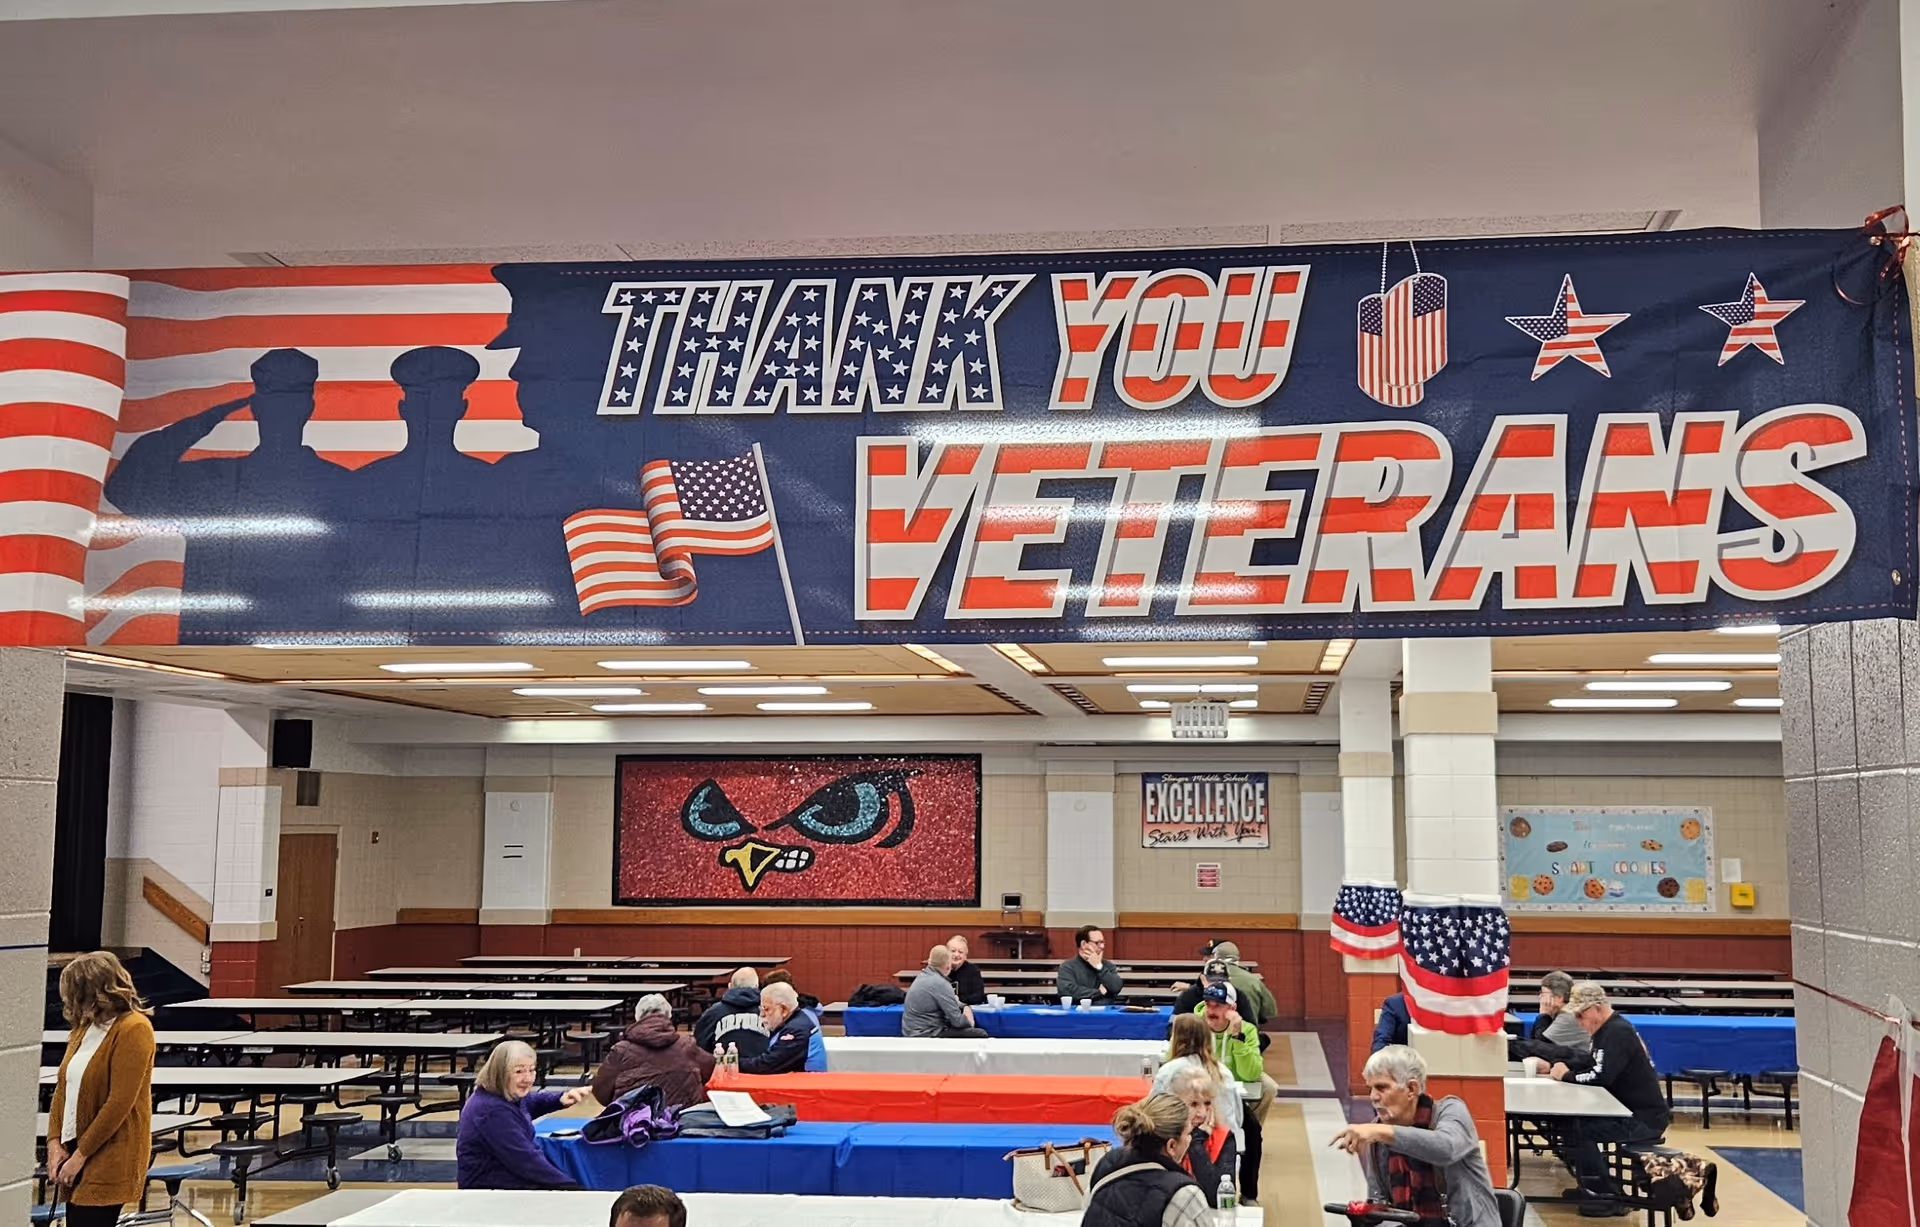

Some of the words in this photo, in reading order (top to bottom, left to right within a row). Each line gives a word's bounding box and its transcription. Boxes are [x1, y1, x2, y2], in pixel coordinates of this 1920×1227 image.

[597, 273, 1035, 415] THANK
[1048, 264, 1311, 411] YOU
[854, 403, 1868, 621] VETERANS
[1192, 774, 1220, 783] Middle
[1222, 773, 1249, 783] School
[1145, 782, 1266, 824] EXCELLENCE
[1148, 828, 1190, 846] Starts
[1193, 822, 1228, 840] With
